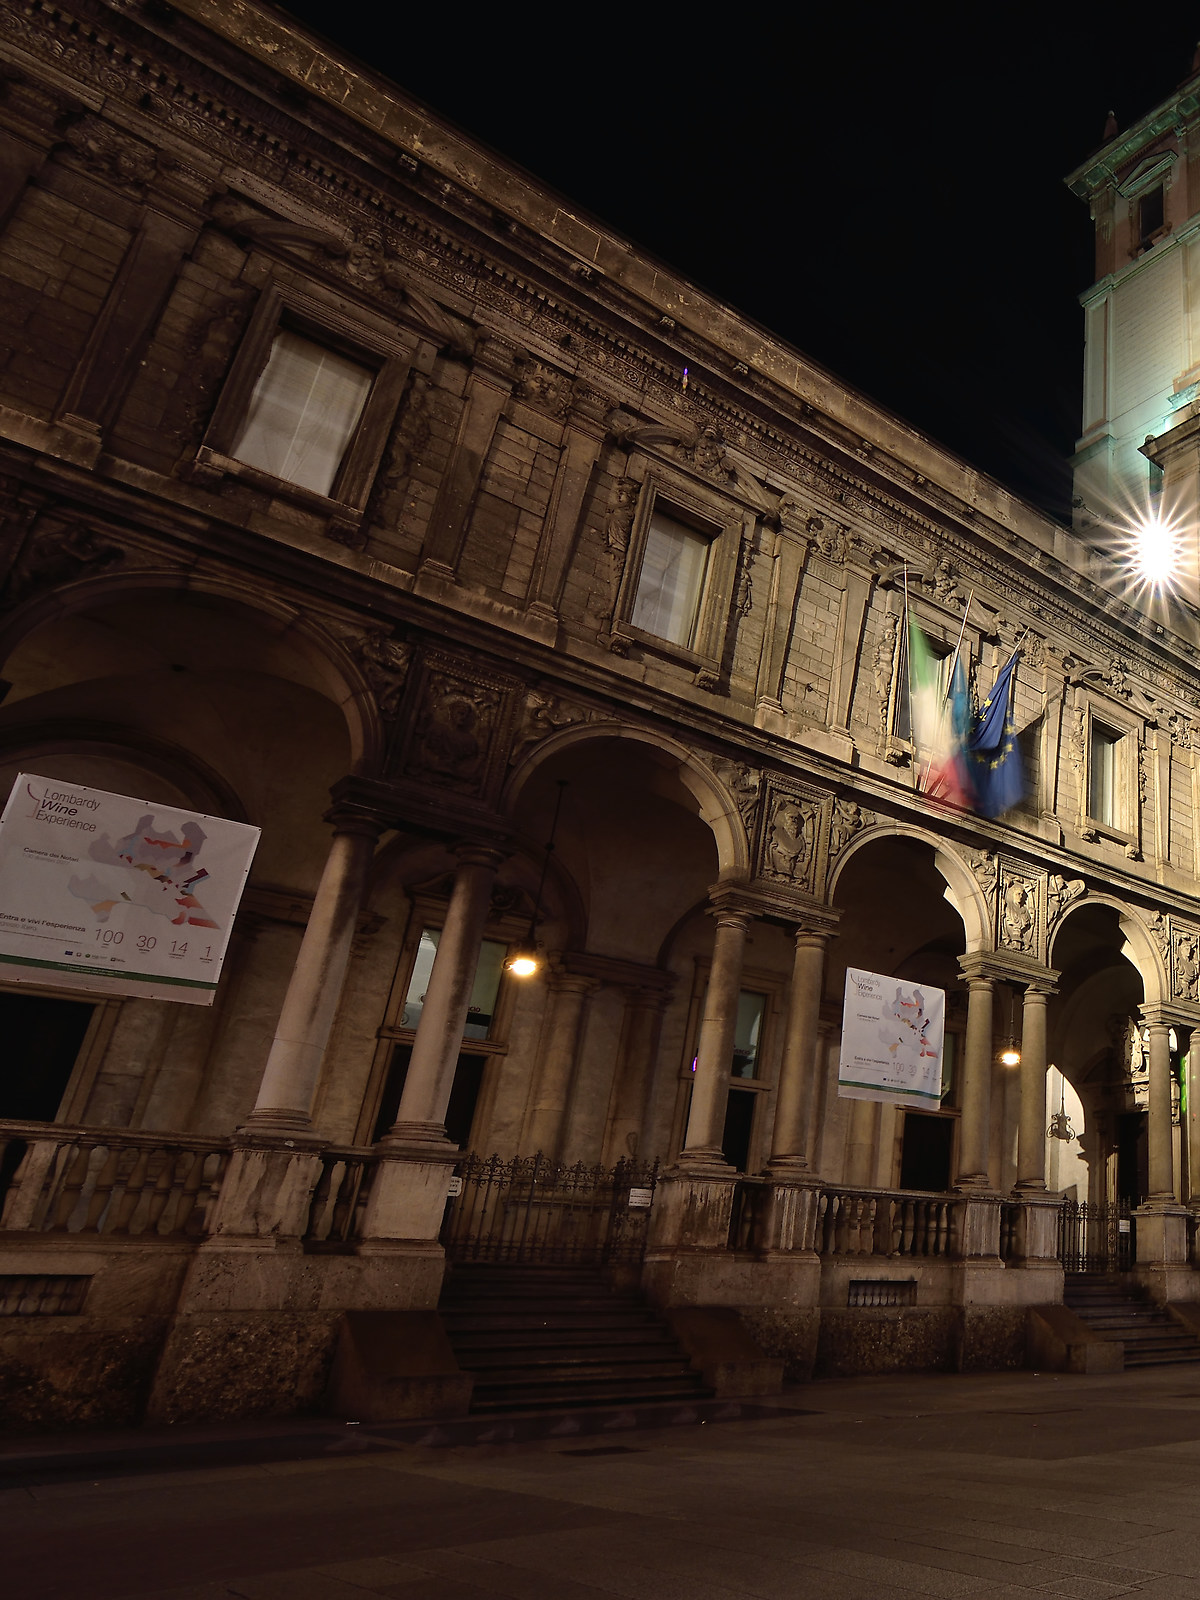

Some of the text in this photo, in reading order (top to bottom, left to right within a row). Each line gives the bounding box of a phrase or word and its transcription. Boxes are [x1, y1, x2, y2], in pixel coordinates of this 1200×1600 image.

[41, 799, 78, 816] Wine
[44, 788, 101, 811] Lombardy
[35, 809, 97, 832] Experience
[95, 928, 211, 958] 100 30 14 1
